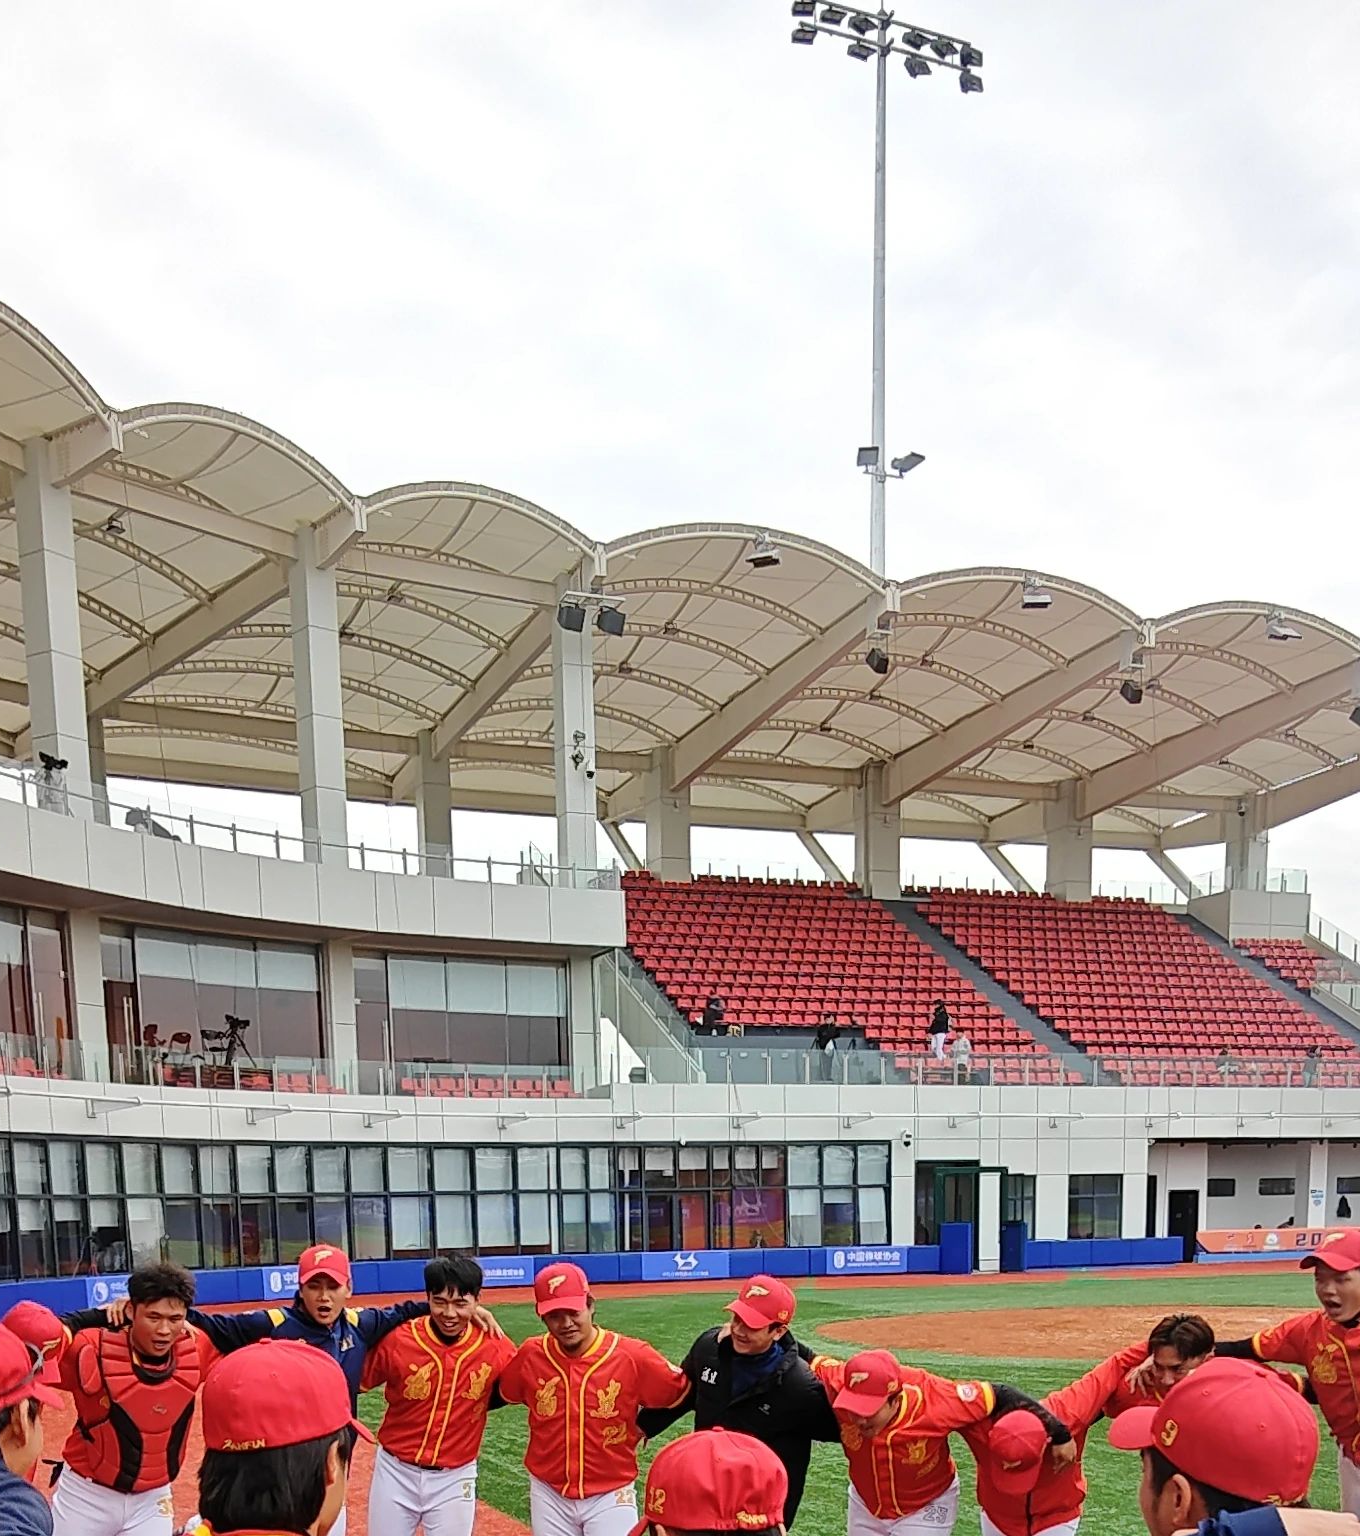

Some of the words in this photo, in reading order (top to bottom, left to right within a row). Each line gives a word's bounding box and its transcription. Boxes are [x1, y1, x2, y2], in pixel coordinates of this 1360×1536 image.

[1161, 1419, 1178, 1446] 9
[648, 1486, 666, 1514] 12
[923, 1506, 949, 1524] 25
